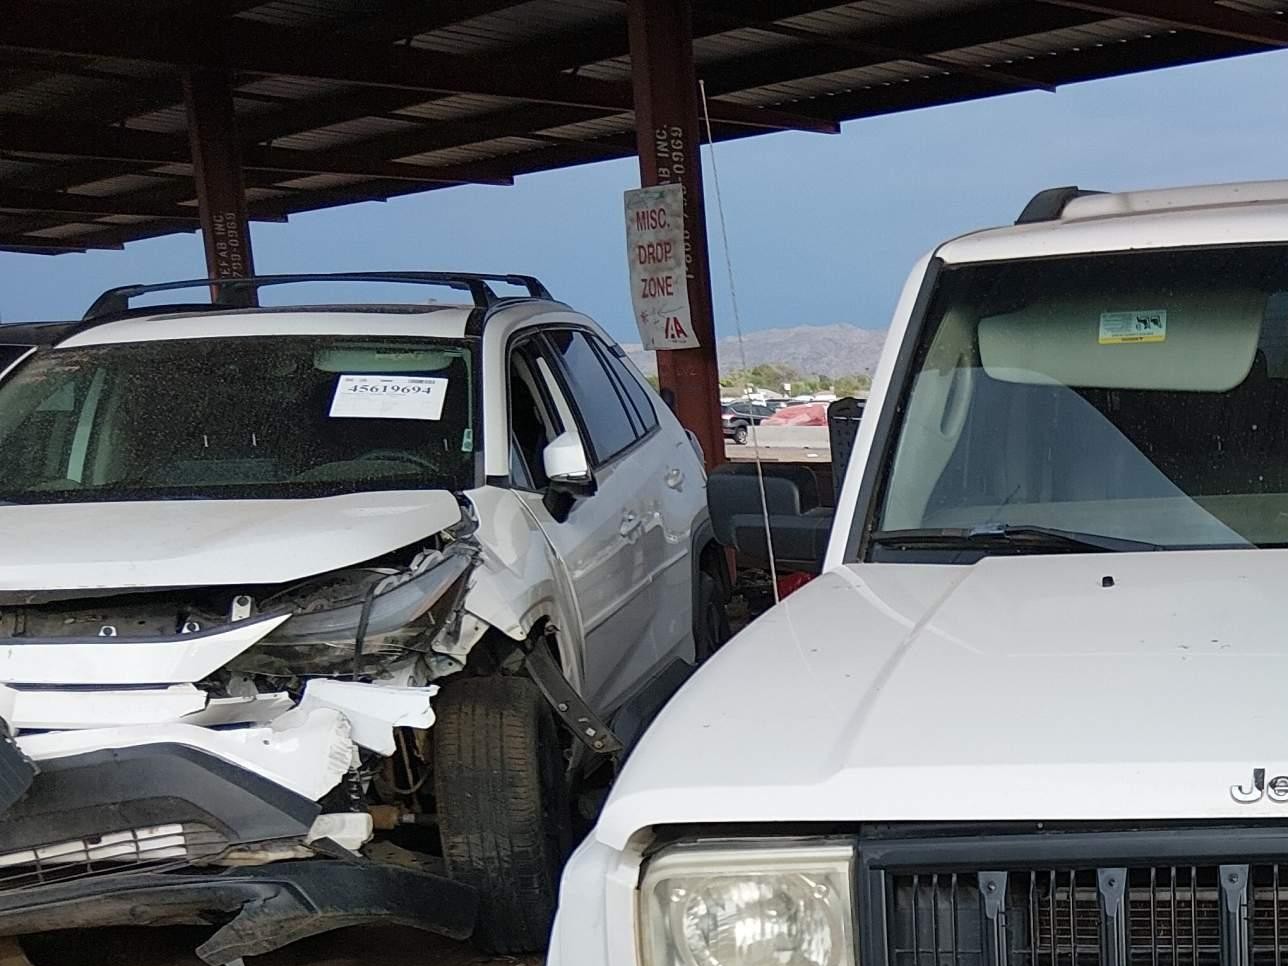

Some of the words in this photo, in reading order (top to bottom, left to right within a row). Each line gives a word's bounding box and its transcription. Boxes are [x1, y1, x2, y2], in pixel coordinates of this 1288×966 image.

[656, 124, 669, 158] INC.
[635, 207, 671, 231] MISC.
[637, 241, 673, 265] DROP
[640, 275, 674, 299] ZONE
[347, 384, 433, 395] 45619694
